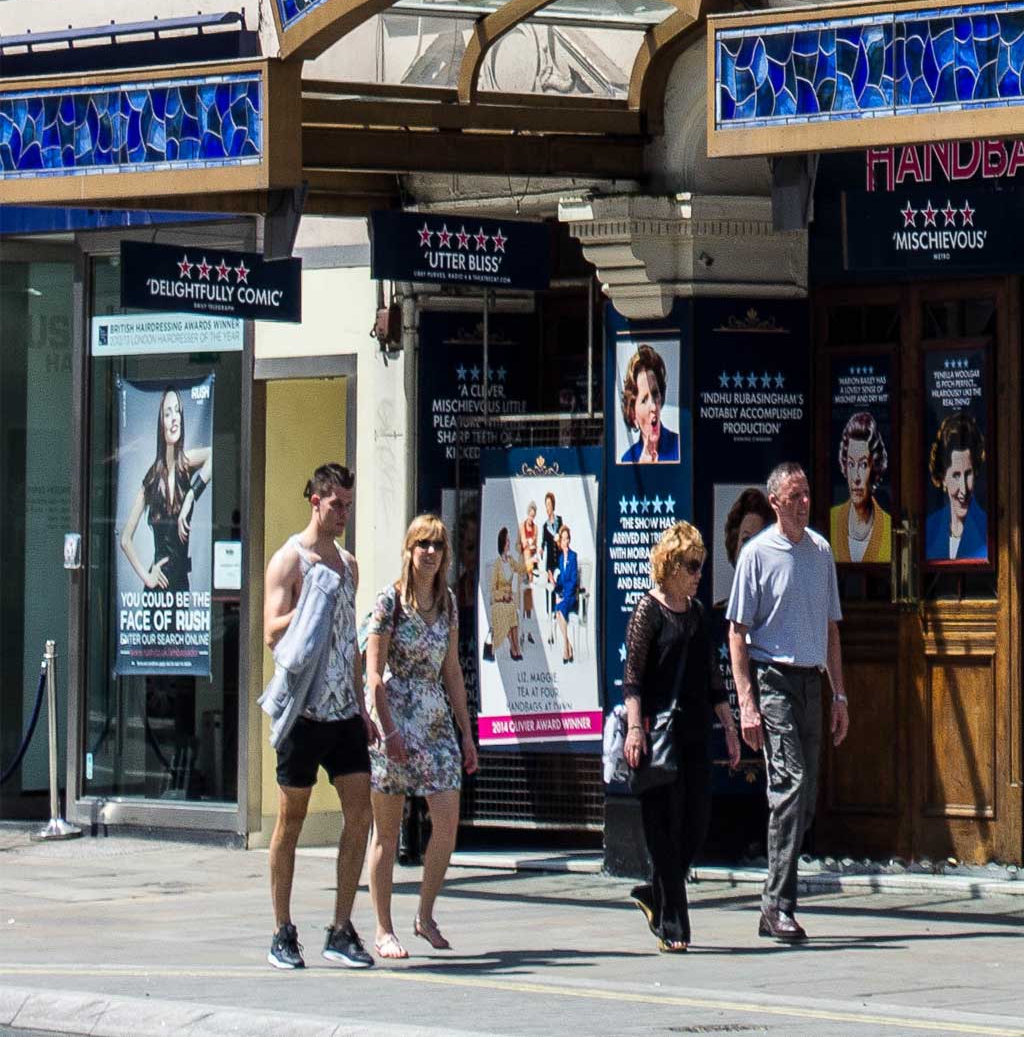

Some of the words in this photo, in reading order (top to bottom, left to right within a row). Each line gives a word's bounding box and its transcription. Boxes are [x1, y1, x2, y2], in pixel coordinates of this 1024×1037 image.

[110, 323, 135, 334] BRITISH
[135, 321, 183, 333] HAIRDRESSING
[184, 320, 212, 332] AWARDS
[212, 318, 241, 330] WINNER
[700, 406, 739, 420] NOTABLY
[740, 407, 804, 421] ACCOMPLISHED
[613, 531, 640, 545] ARRIVED
[609, 546, 627, 560] WITH
[627, 546, 651, 560] MOIRA
[617, 576, 634, 590] AND
[120, 591, 142, 609] YOU
[142, 591, 174, 609] COULD
[175, 591, 190, 609] BE
[191, 592, 211, 609] THE
[120, 610, 151, 632] FACE
[153, 610, 173, 632] OF
[175, 610, 211, 632] RUSH
[120, 633, 141, 645] ENTER
[142, 633, 157, 645] OUR
[157, 632, 184, 645] SEARCH
[184, 632, 210, 646] ONLINE
[509, 718, 536, 734] OLIVIER
[536, 717, 562, 733] AWARD
[561, 715, 593, 732] WINNER
